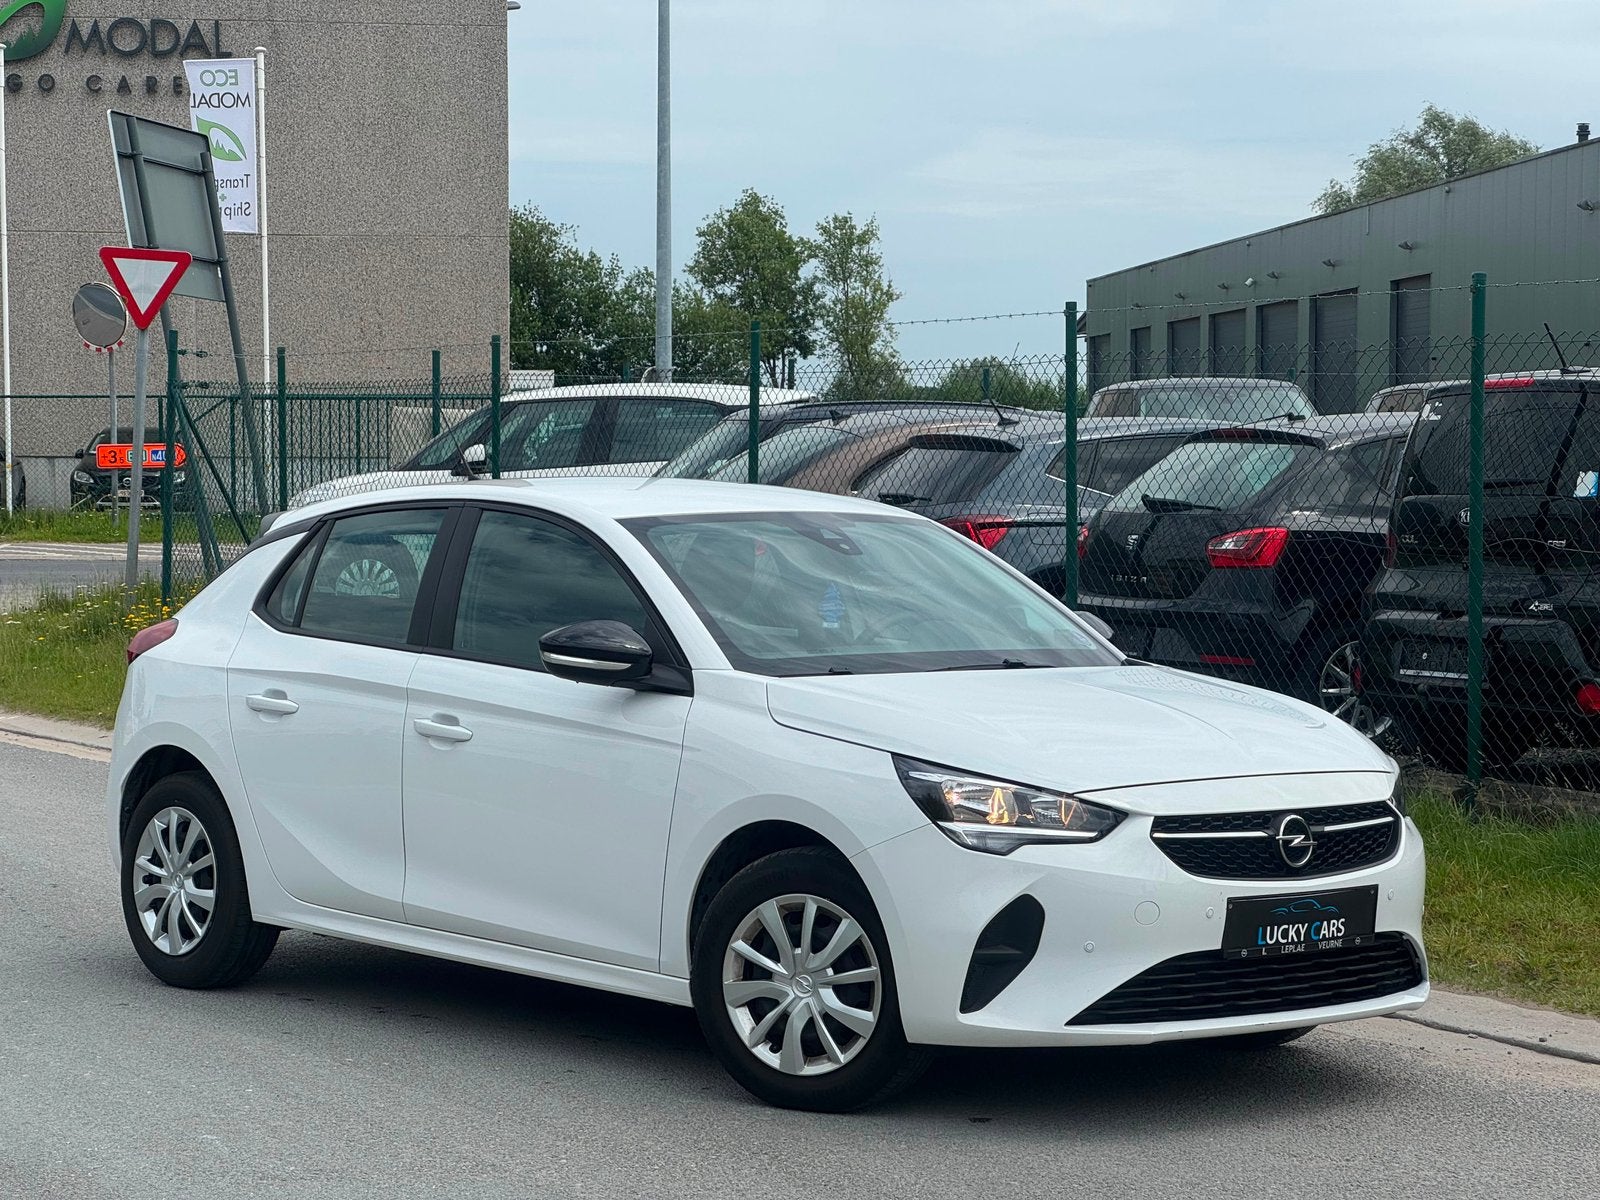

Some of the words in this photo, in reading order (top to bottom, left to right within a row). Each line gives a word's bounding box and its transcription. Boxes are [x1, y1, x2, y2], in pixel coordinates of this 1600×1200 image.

[65, 17, 232, 56] MODAL
[1258, 923, 1308, 945] LUCKY
[1311, 918, 1345, 940] CARS
[1280, 943, 1305, 954] LEPLAE
[1318, 938, 1343, 949] VEURNE
